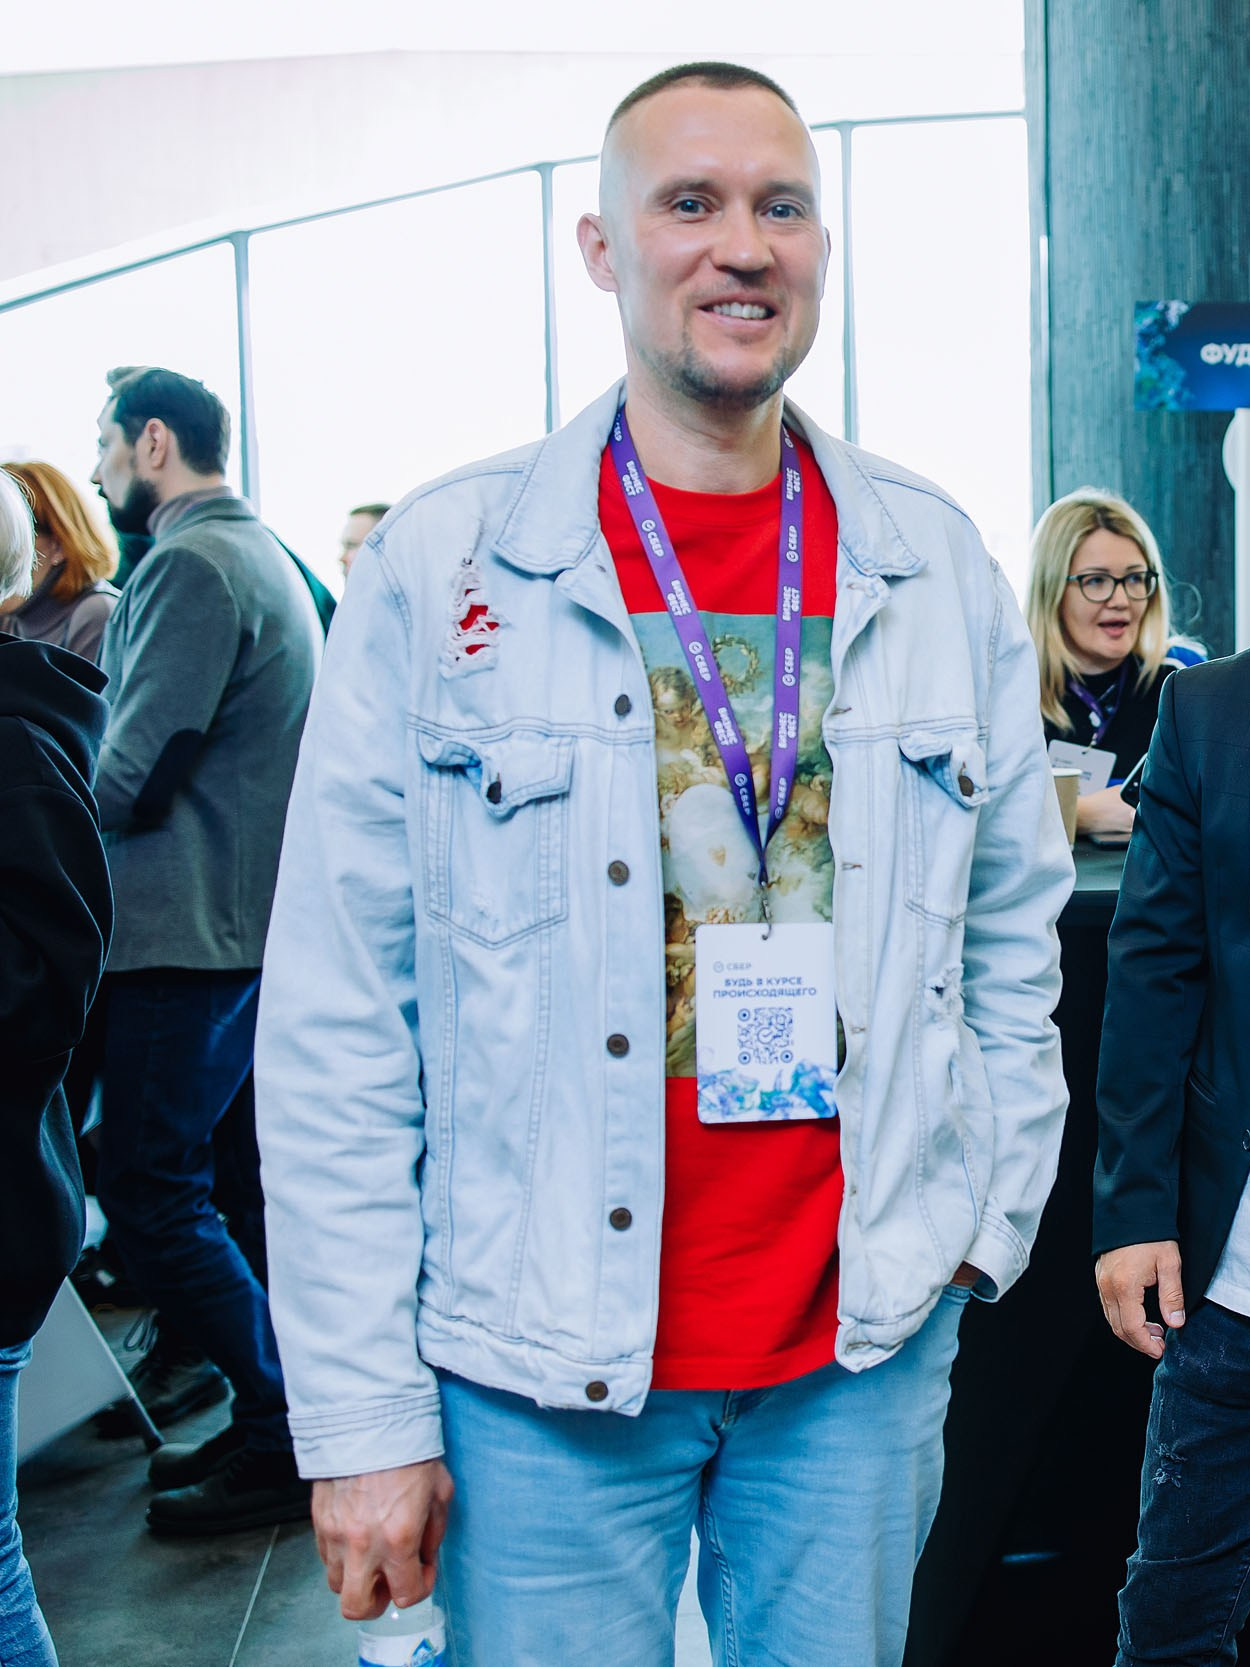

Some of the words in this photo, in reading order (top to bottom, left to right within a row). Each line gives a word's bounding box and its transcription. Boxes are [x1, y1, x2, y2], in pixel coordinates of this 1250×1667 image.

[626, 460, 644, 494] БИЗНЕС
[786, 467, 794, 501] БИЗНЕС
[647, 532, 665, 558] СБЕР
[788, 525, 798, 550] СБЕР
[671, 580, 692, 615] БИЗНЕС
[782, 585, 791, 621] БИЗНЕС
[695, 654, 712, 682] СБЕР
[784, 647, 794, 674] СБЕР
[718, 707, 738, 745] БИЗНЕС
[778, 712, 787, 749] БИЗНЕС
[740, 787, 751, 816] СБЕР
[778, 777, 787, 806] СБЕР
[712, 987, 817, 999] ПРОИСХОДЯЩЕГО
[724, 978, 753, 988] БУДЬ
[756, 978, 763, 986] В
[766, 976, 803, 986] КУРСЕ
